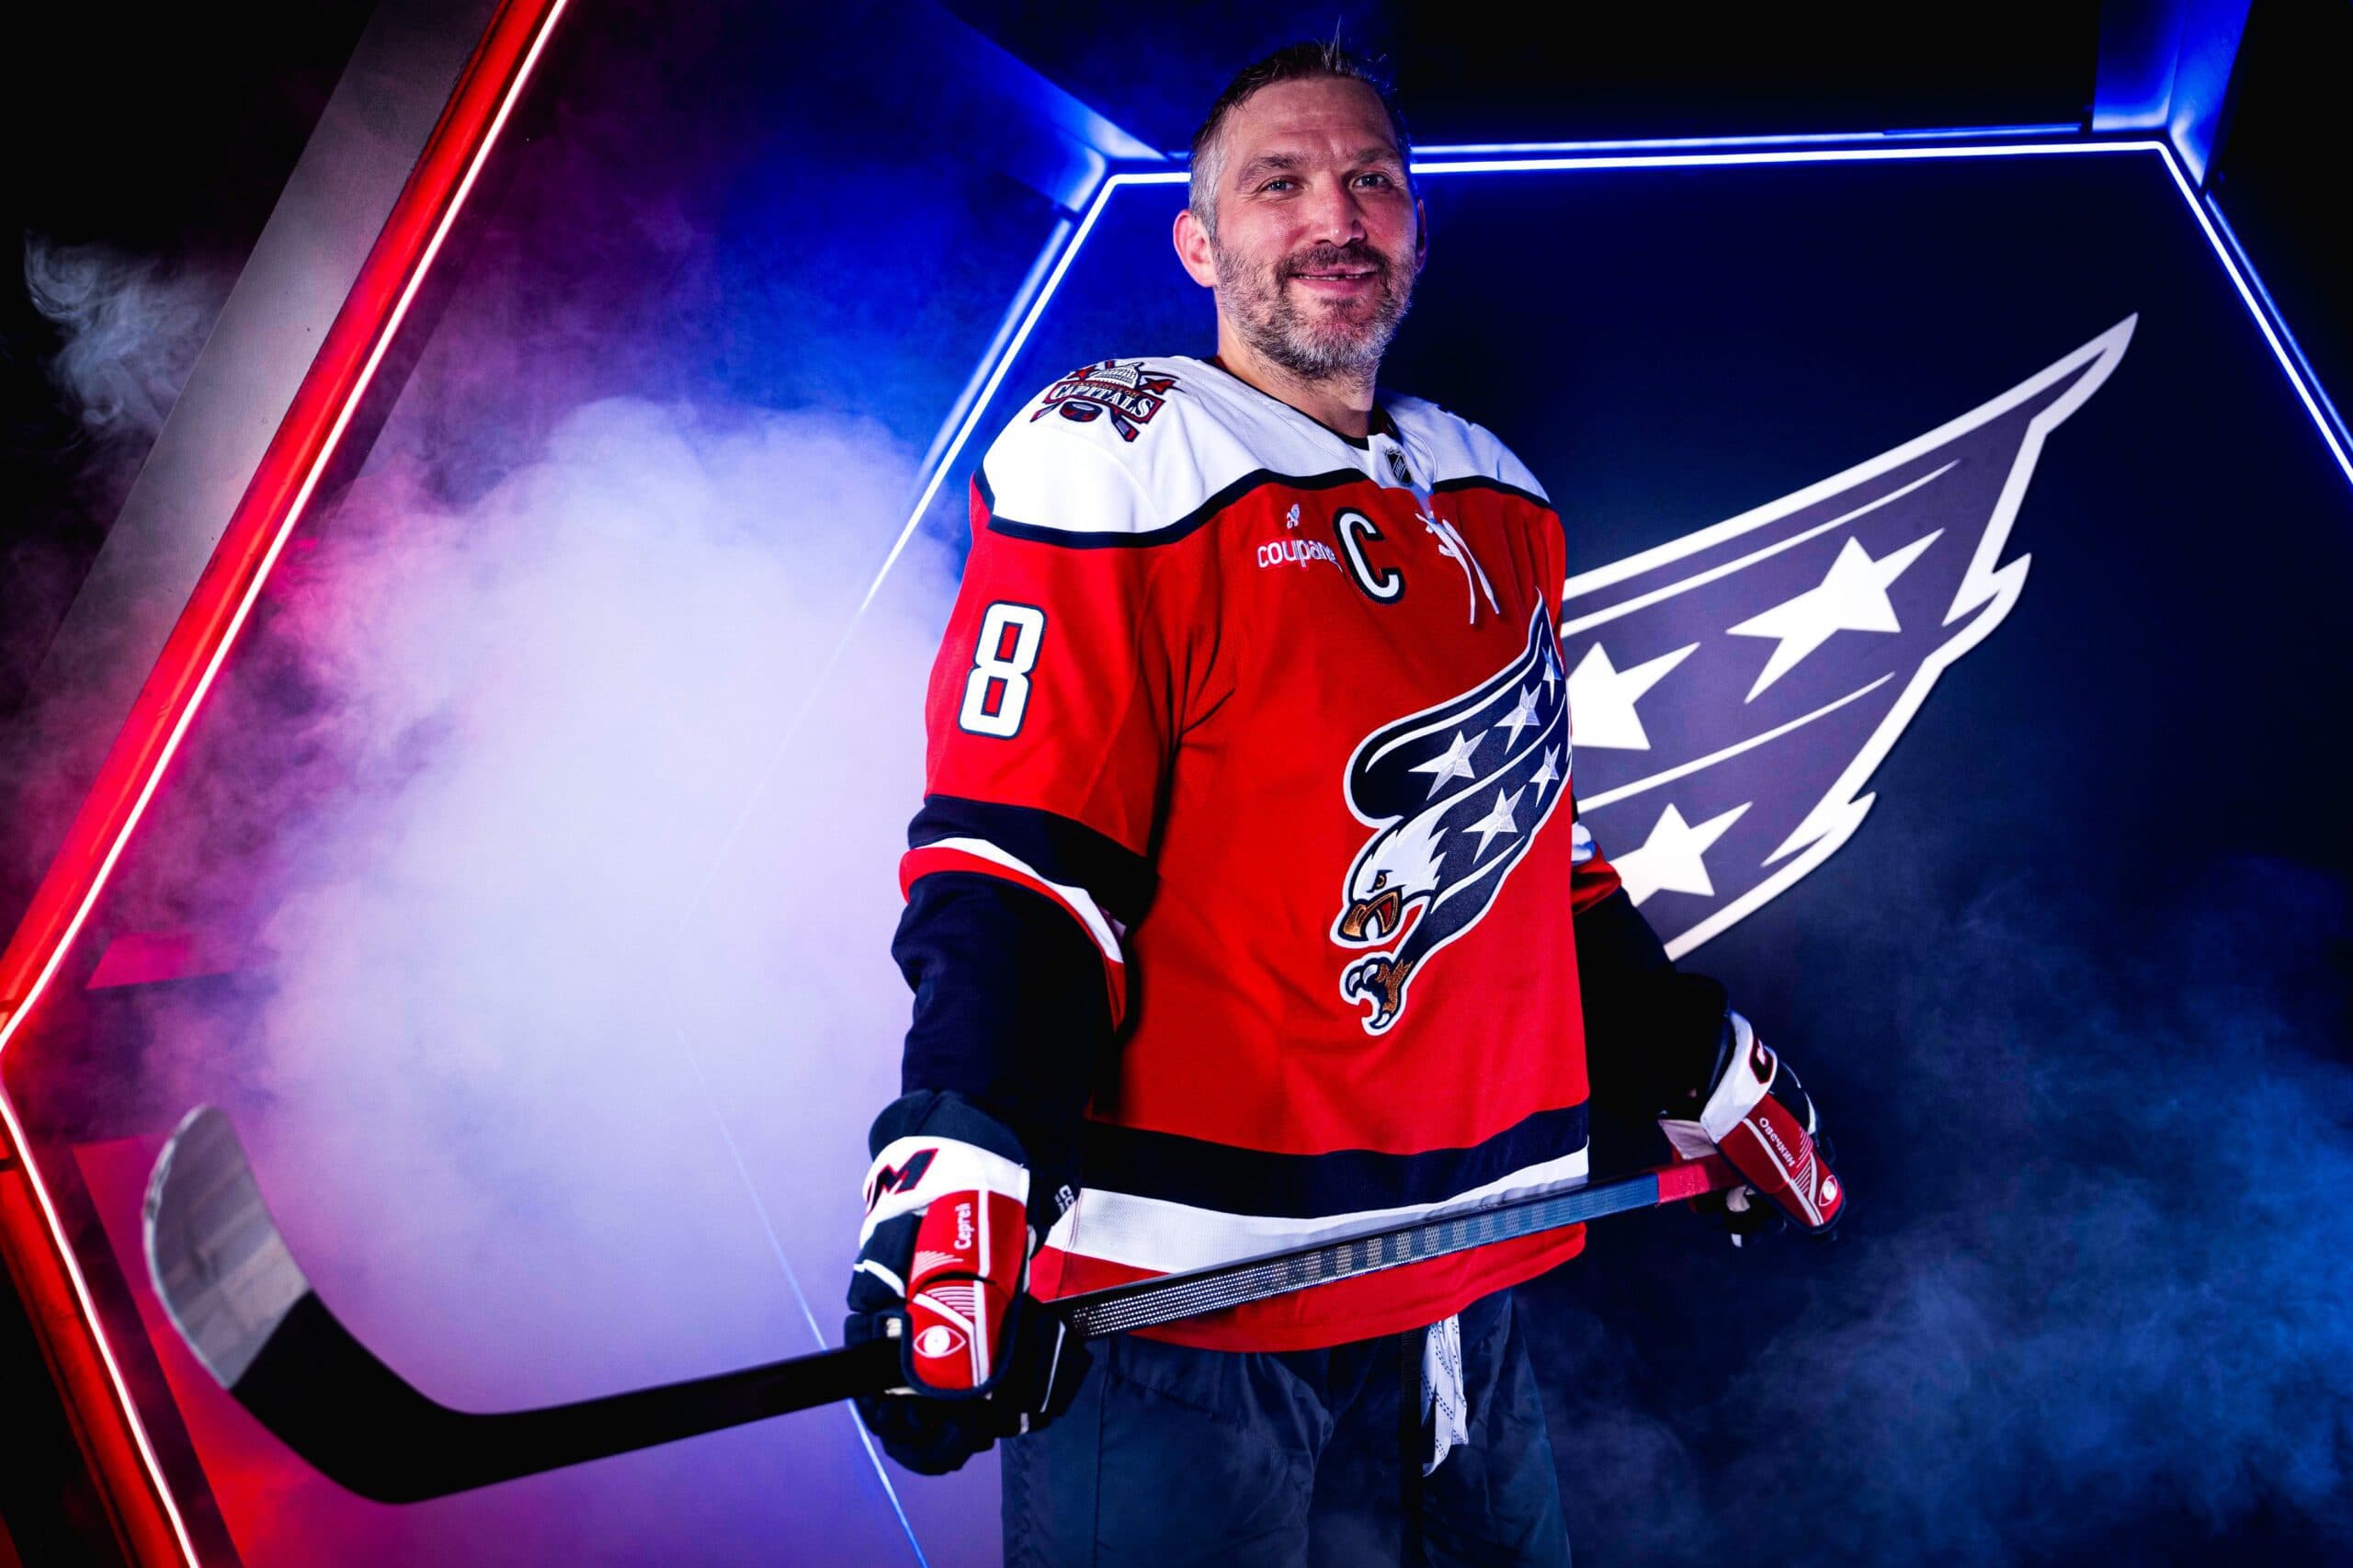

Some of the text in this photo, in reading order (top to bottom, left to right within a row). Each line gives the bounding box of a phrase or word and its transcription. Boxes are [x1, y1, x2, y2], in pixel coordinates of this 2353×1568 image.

[1049, 383, 1155, 418] CAPITALS
[1333, 506, 1406, 606] C
[957, 599, 1048, 741] 8
[1758, 1117, 1796, 1168] Овечкин
